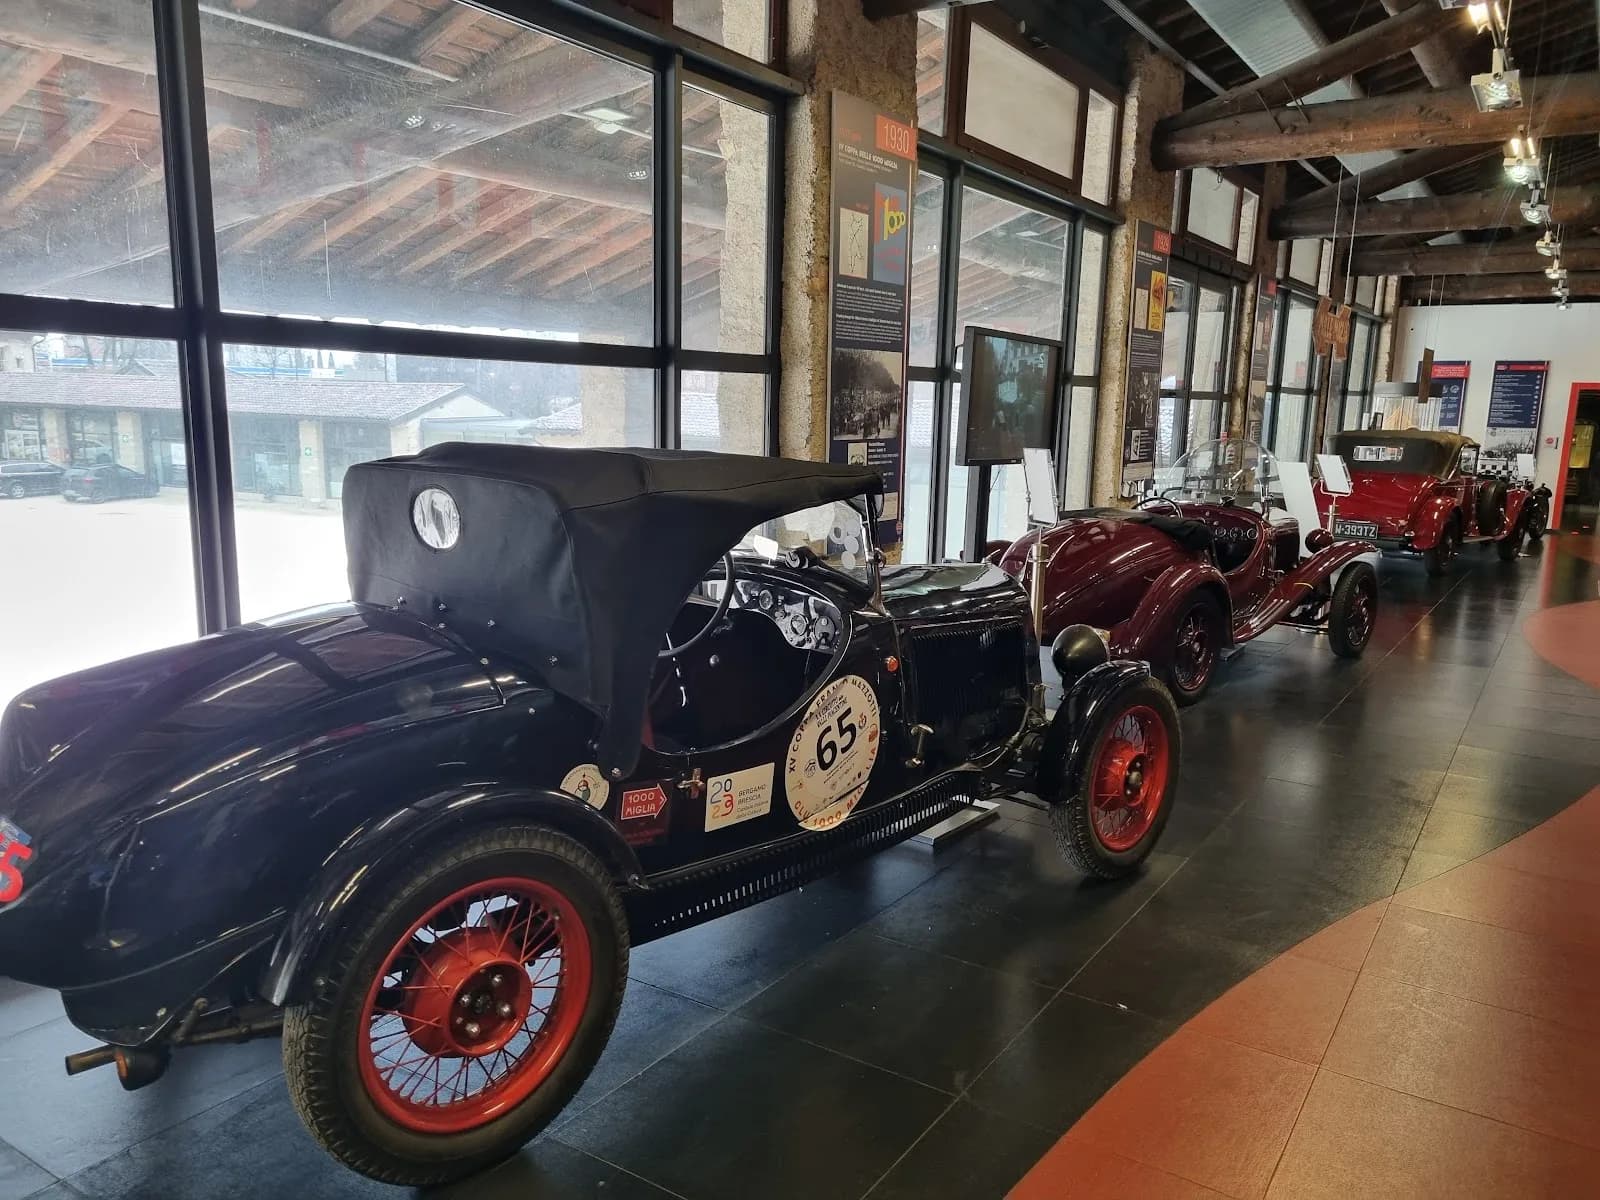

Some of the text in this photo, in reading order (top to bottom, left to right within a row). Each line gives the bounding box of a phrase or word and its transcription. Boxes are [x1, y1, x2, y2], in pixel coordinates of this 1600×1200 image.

[884, 123, 910, 154] 1930
[816, 678, 849, 707] FRANO
[792, 711, 815, 752] COPPA
[816, 707, 857, 771] 65
[788, 757, 797, 774] XV
[628, 792, 655, 804] 1000
[710, 778, 733, 804] 20
[738, 783, 768, 797] BERGAMO
[625, 803, 656, 816] MIGLIA
[794, 800, 815, 824] CLU
[814, 810, 842, 828] 1000
